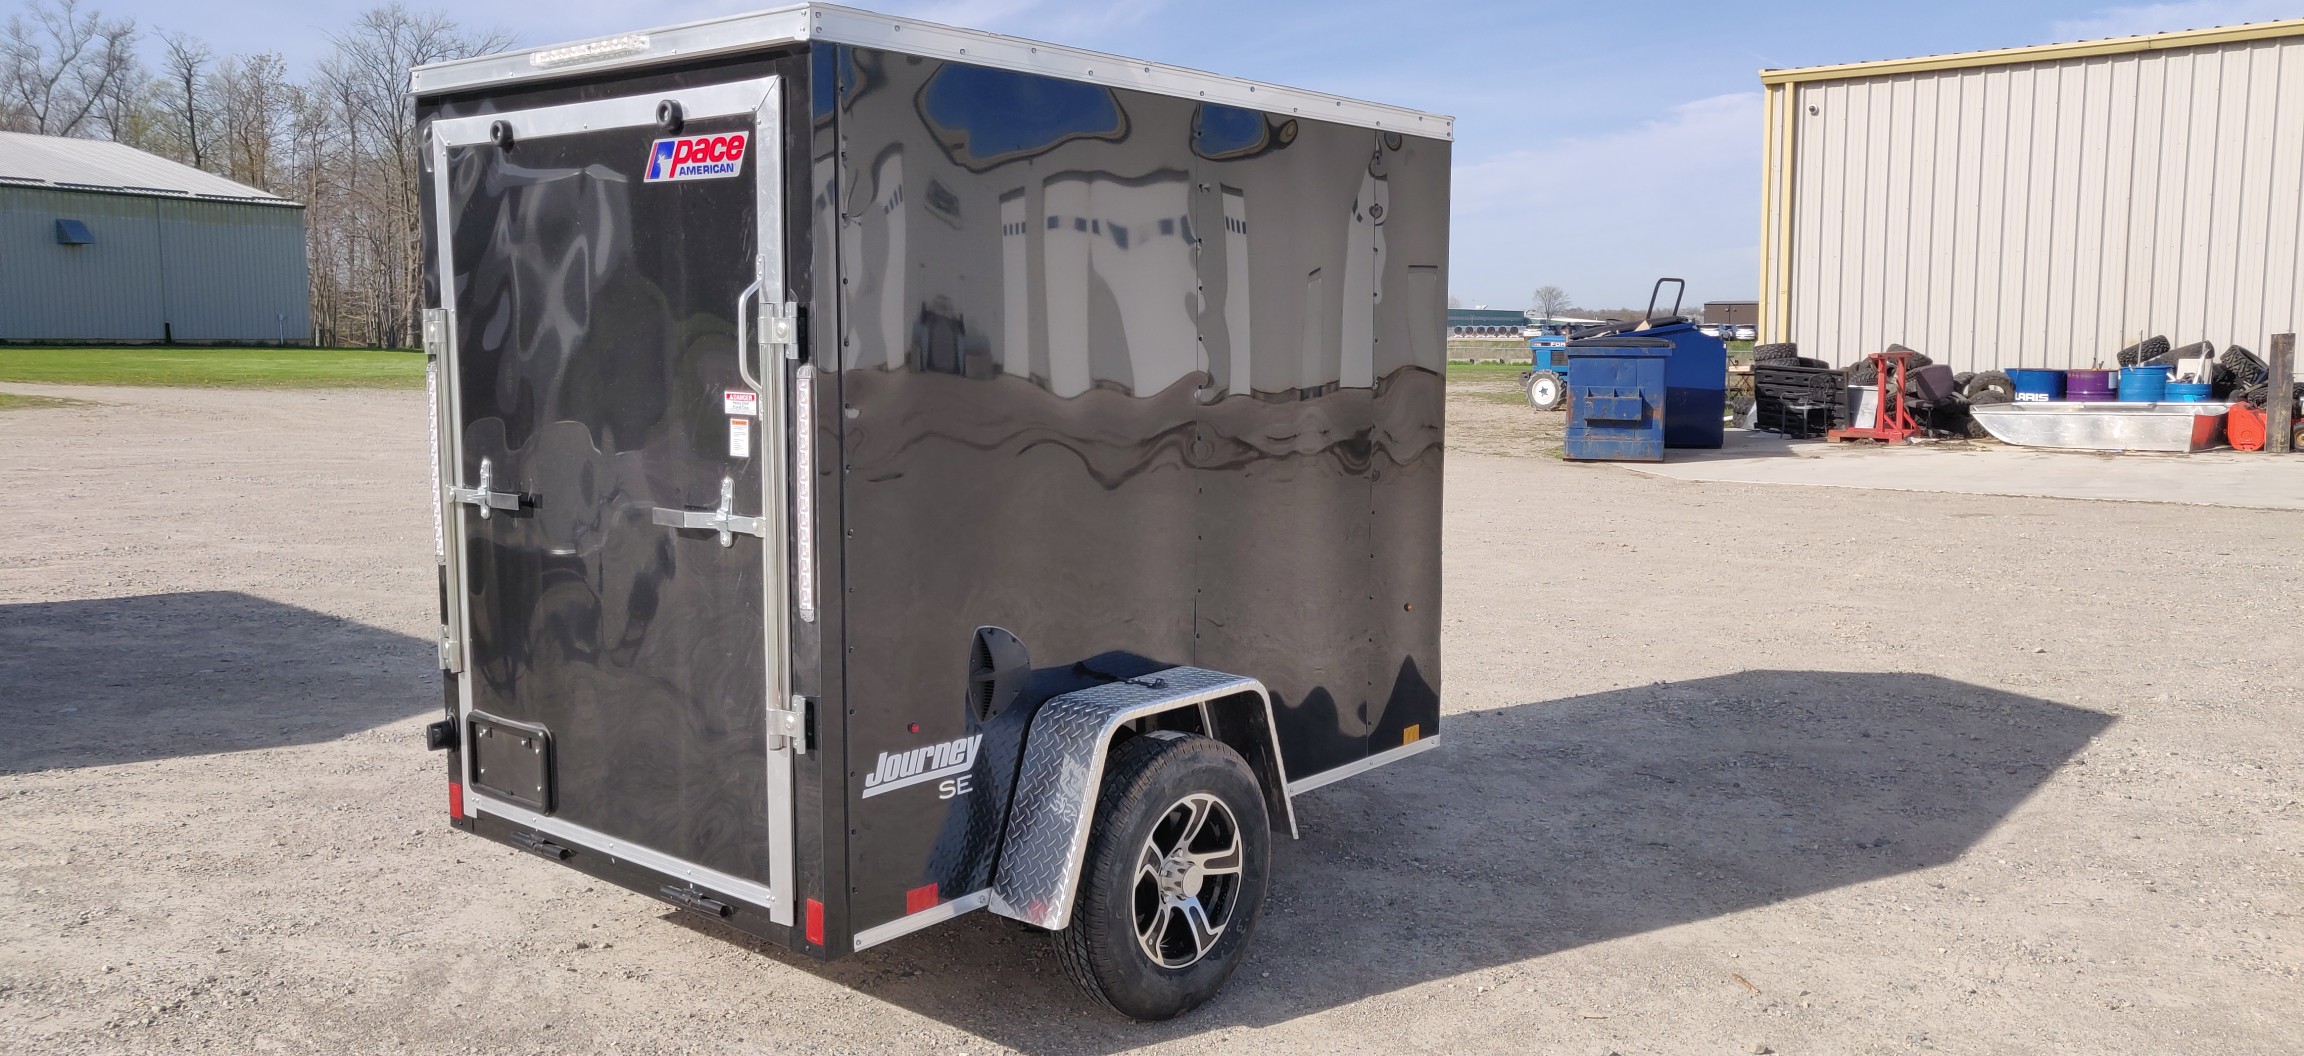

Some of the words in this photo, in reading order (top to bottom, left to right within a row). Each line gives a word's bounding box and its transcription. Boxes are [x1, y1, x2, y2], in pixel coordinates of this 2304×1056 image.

[669, 135, 745, 178] pace
[679, 163, 734, 176] AMERICAN
[863, 734, 983, 792] Journey
[939, 774, 973, 799] SE
